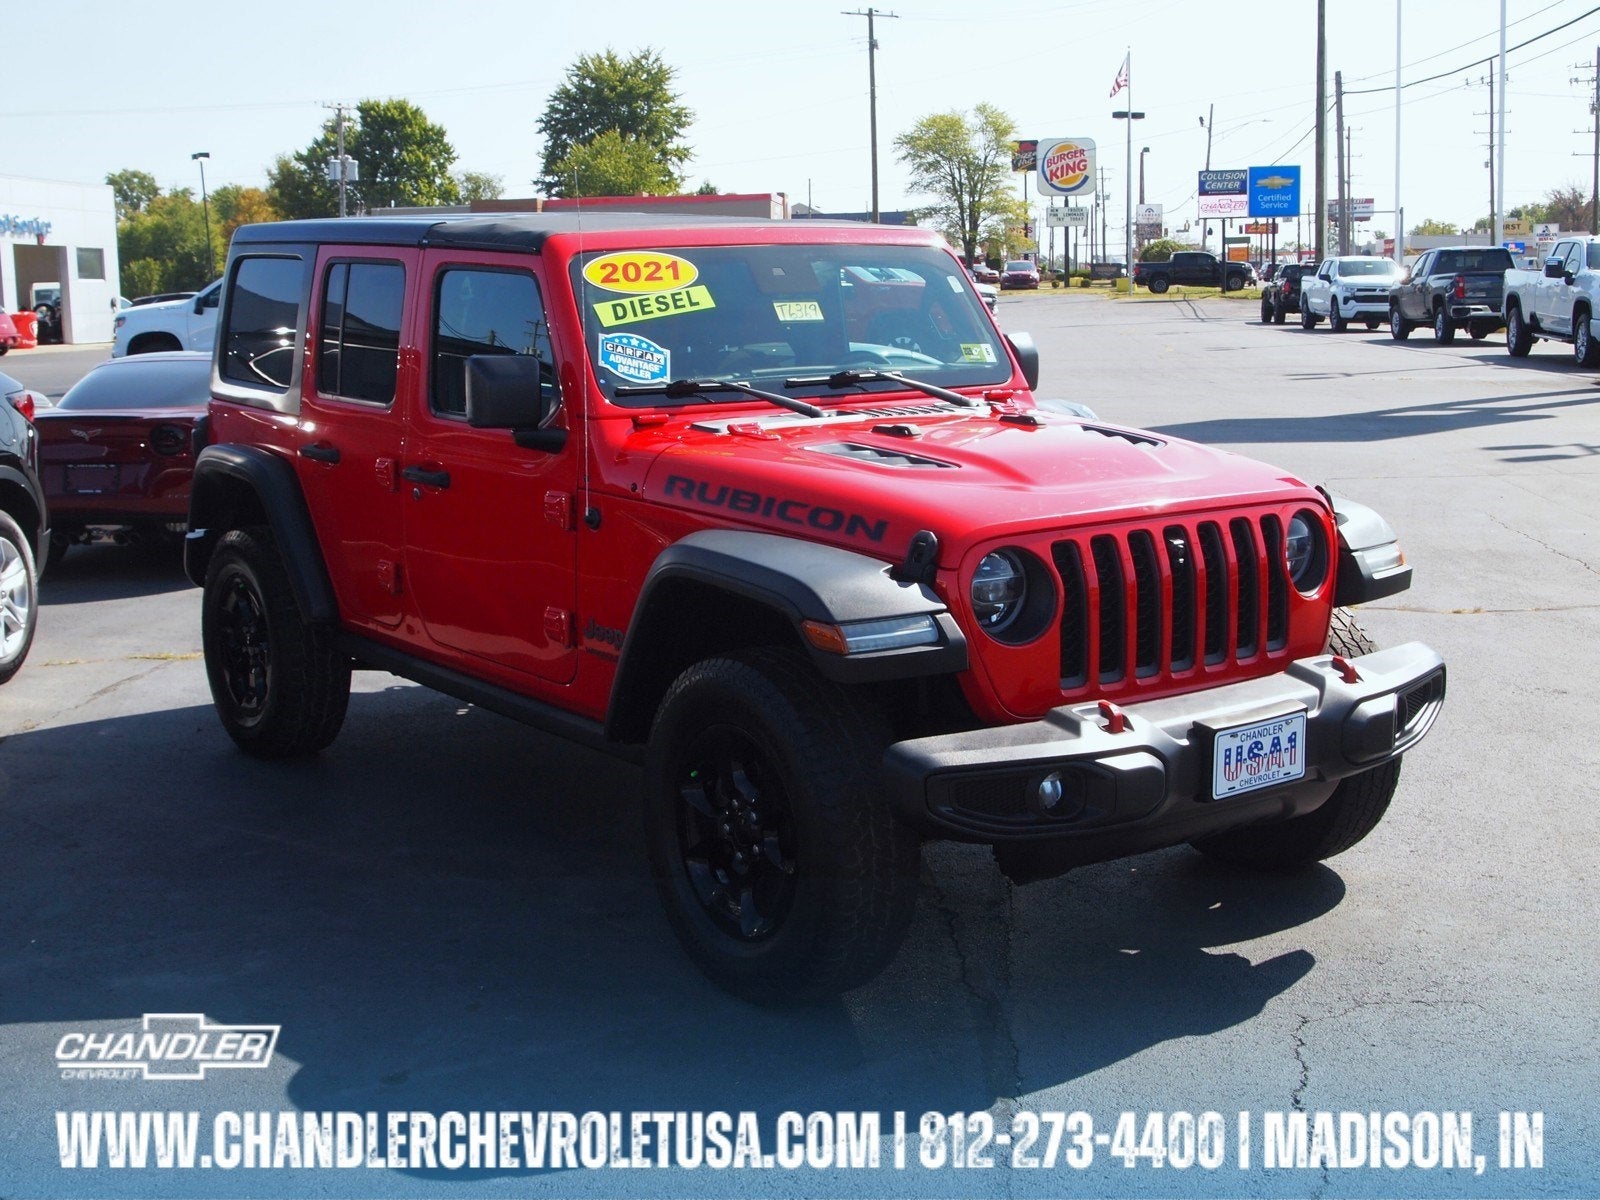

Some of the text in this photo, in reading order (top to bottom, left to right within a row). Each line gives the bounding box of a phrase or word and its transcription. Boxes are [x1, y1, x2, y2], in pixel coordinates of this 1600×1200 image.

[1046, 148, 1086, 168] BURGER
[1049, 158, 1088, 182] KING
[1201, 171, 1247, 181] COLLISION
[1205, 181, 1240, 190] CENTER
[1200, 202, 1245, 210] CHANDLER
[1258, 194, 1292, 202] Certified
[1260, 201, 1289, 209] Service
[600, 260, 680, 284] 2021
[611, 290, 700, 321] DIESEL
[604, 341, 665, 366] CARFAX
[608, 353, 662, 374] ADVANTAGE
[617, 363, 652, 380] DEALER
[663, 474, 890, 543] RUBICON
[583, 616, 625, 650] Jeep
[1239, 723, 1284, 743] CHANDLER
[1239, 769, 1281, 788] CHEVROLET
